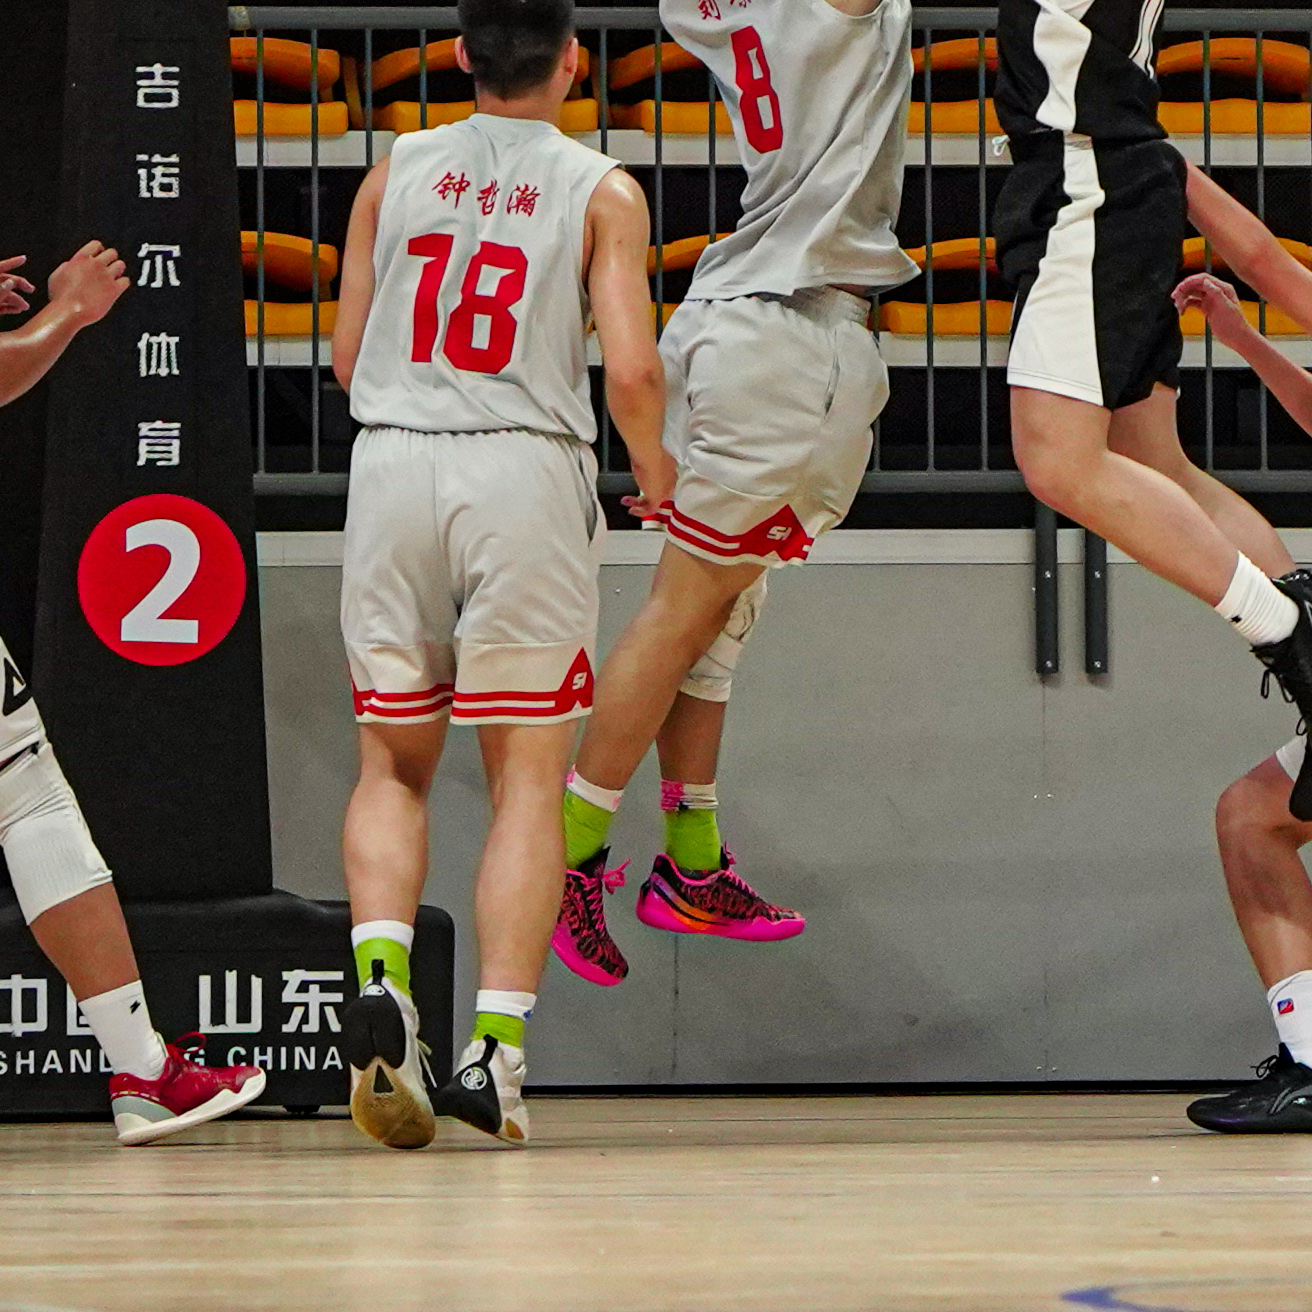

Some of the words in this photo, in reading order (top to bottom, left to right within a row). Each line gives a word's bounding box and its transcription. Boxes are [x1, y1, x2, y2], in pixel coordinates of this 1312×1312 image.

[730, 25, 784, 155] 8
[135, 63, 181, 466] 吉诺尔体育
[408, 232, 529, 375] 18
[120, 518, 202, 643] 2
[198, 969, 344, 1034] 山东
[228, 1045, 344, 1072] CHINA
